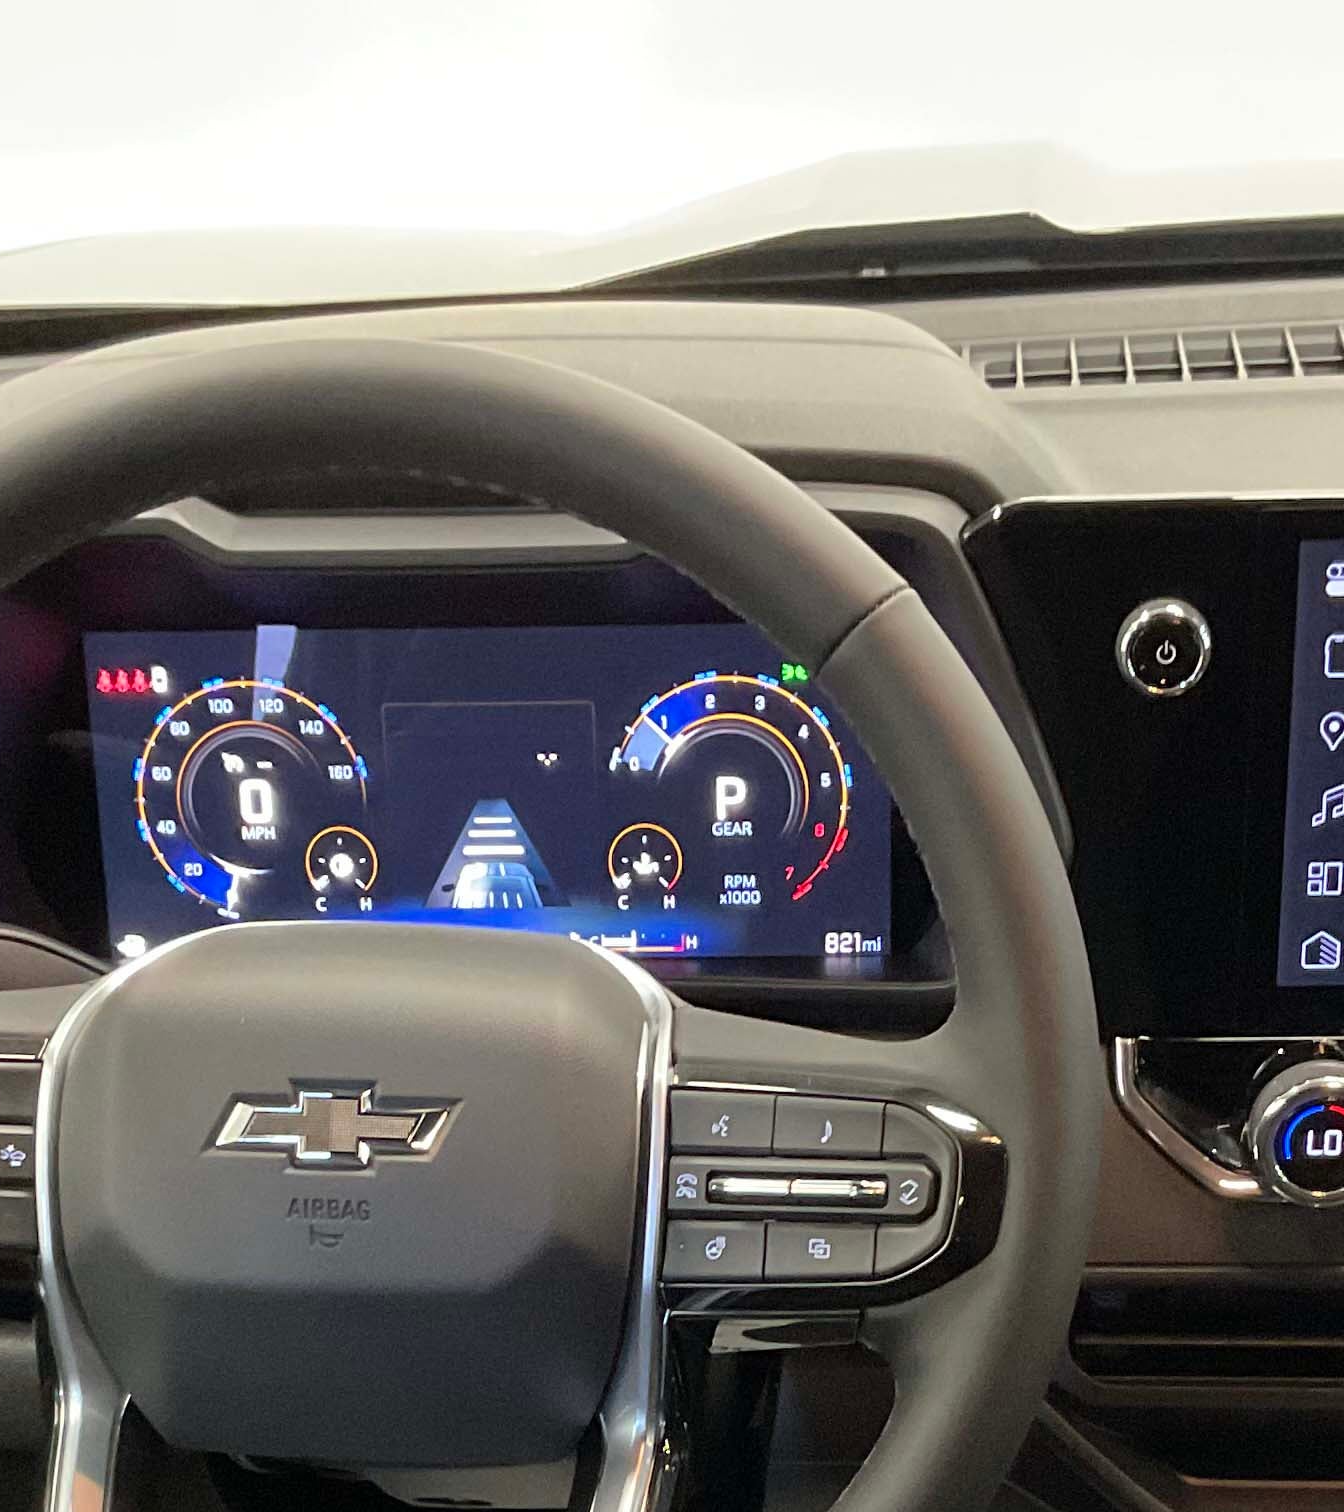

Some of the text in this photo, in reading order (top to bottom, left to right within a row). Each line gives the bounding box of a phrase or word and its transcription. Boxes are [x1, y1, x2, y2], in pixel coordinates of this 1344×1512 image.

[208, 698, 233, 714] 100
[259, 698, 284, 714] 120
[704, 693, 716, 709] 2
[754, 694, 766, 710] 3
[299, 719, 324, 736] 140
[660, 715, 668, 730] 1
[797, 723, 809, 740] 4
[328, 765, 353, 780] 160
[238, 778, 273, 825] 0
[715, 776, 747, 821] P
[156, 820, 176, 835] 40
[241, 826, 276, 841] MPH
[711, 821, 753, 837] GEAR
[184, 862, 203, 877] 20
[724, 874, 756, 889] RPM
[315, 897, 328, 912] C
[360, 896, 373, 912] H
[617, 895, 630, 911] C
[663, 895, 676, 910] H
[719, 890, 762, 906] x1000
[1307, 1129, 1343, 1156] LO
[286, 1197, 371, 1221] AIRBAG
